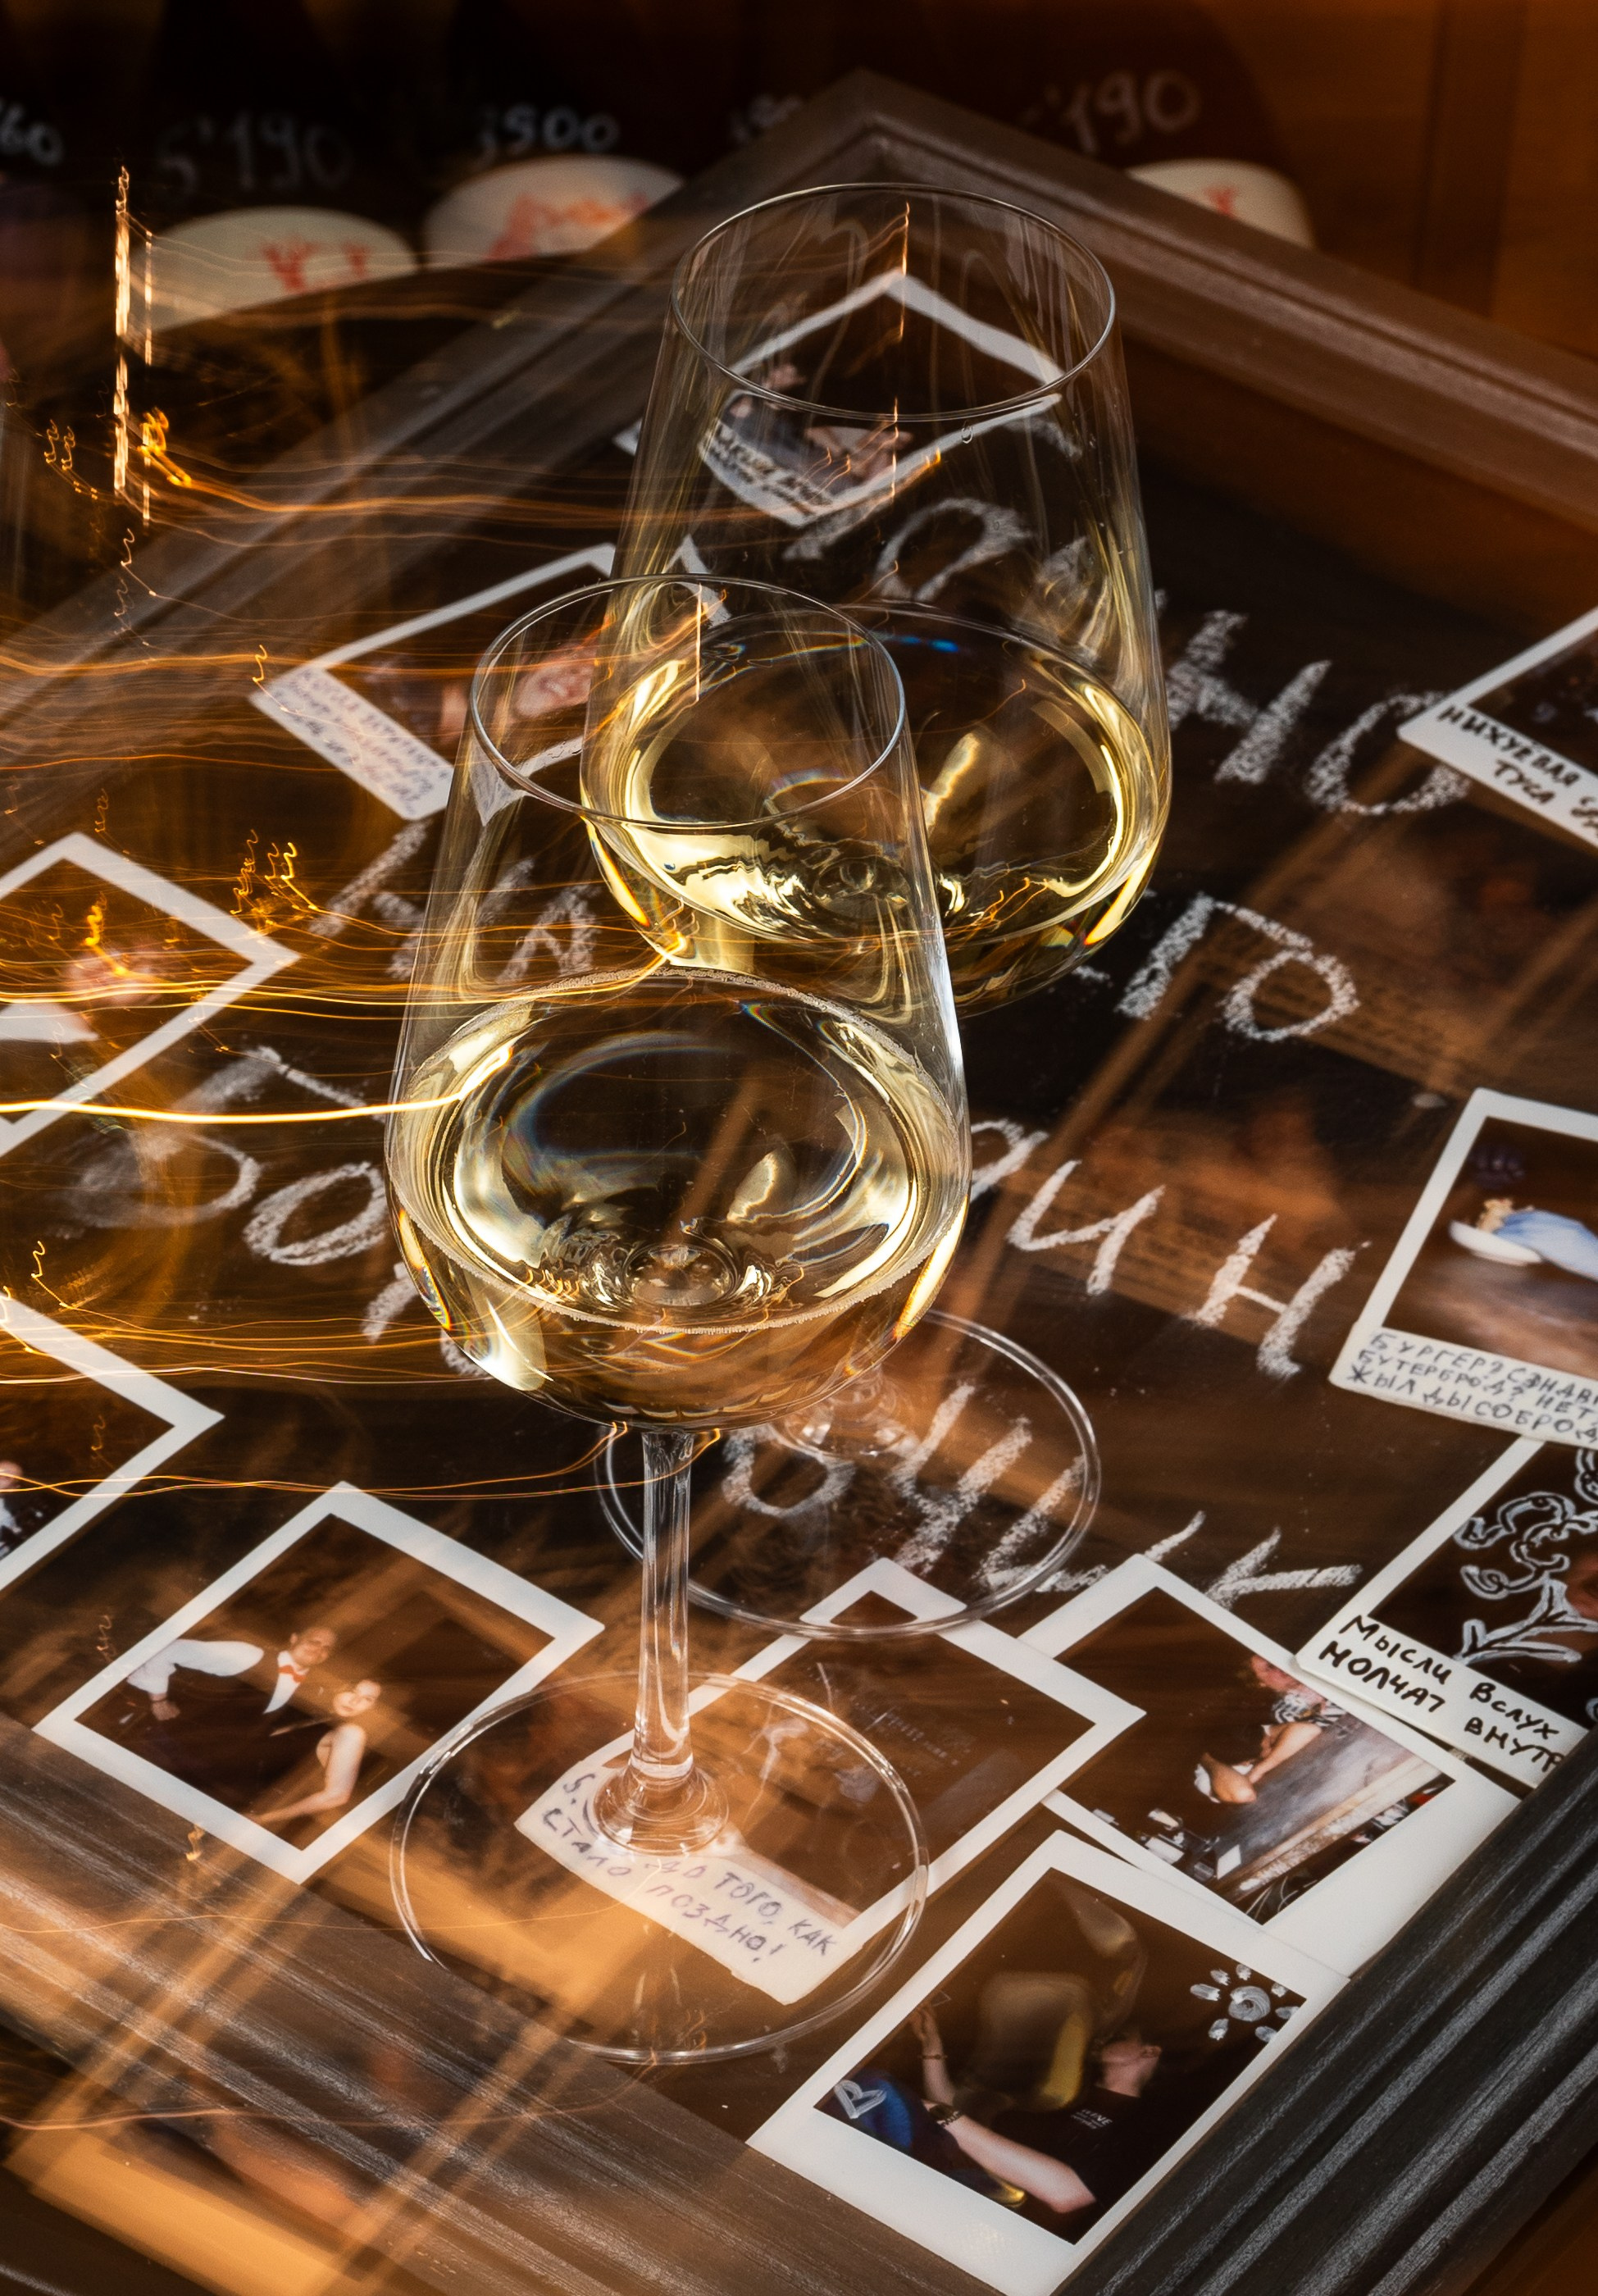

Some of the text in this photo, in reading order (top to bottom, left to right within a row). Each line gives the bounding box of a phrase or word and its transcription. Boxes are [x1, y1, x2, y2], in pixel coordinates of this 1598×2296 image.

[1358, 1349, 1524, 1402] БУТЕРБРОД?
[1370, 1332, 1504, 1379] БУРГЕР?
[543, 1807, 786, 1962] СТАЛО ПОЗДНО!
[787, 1918, 838, 1957] КАК
